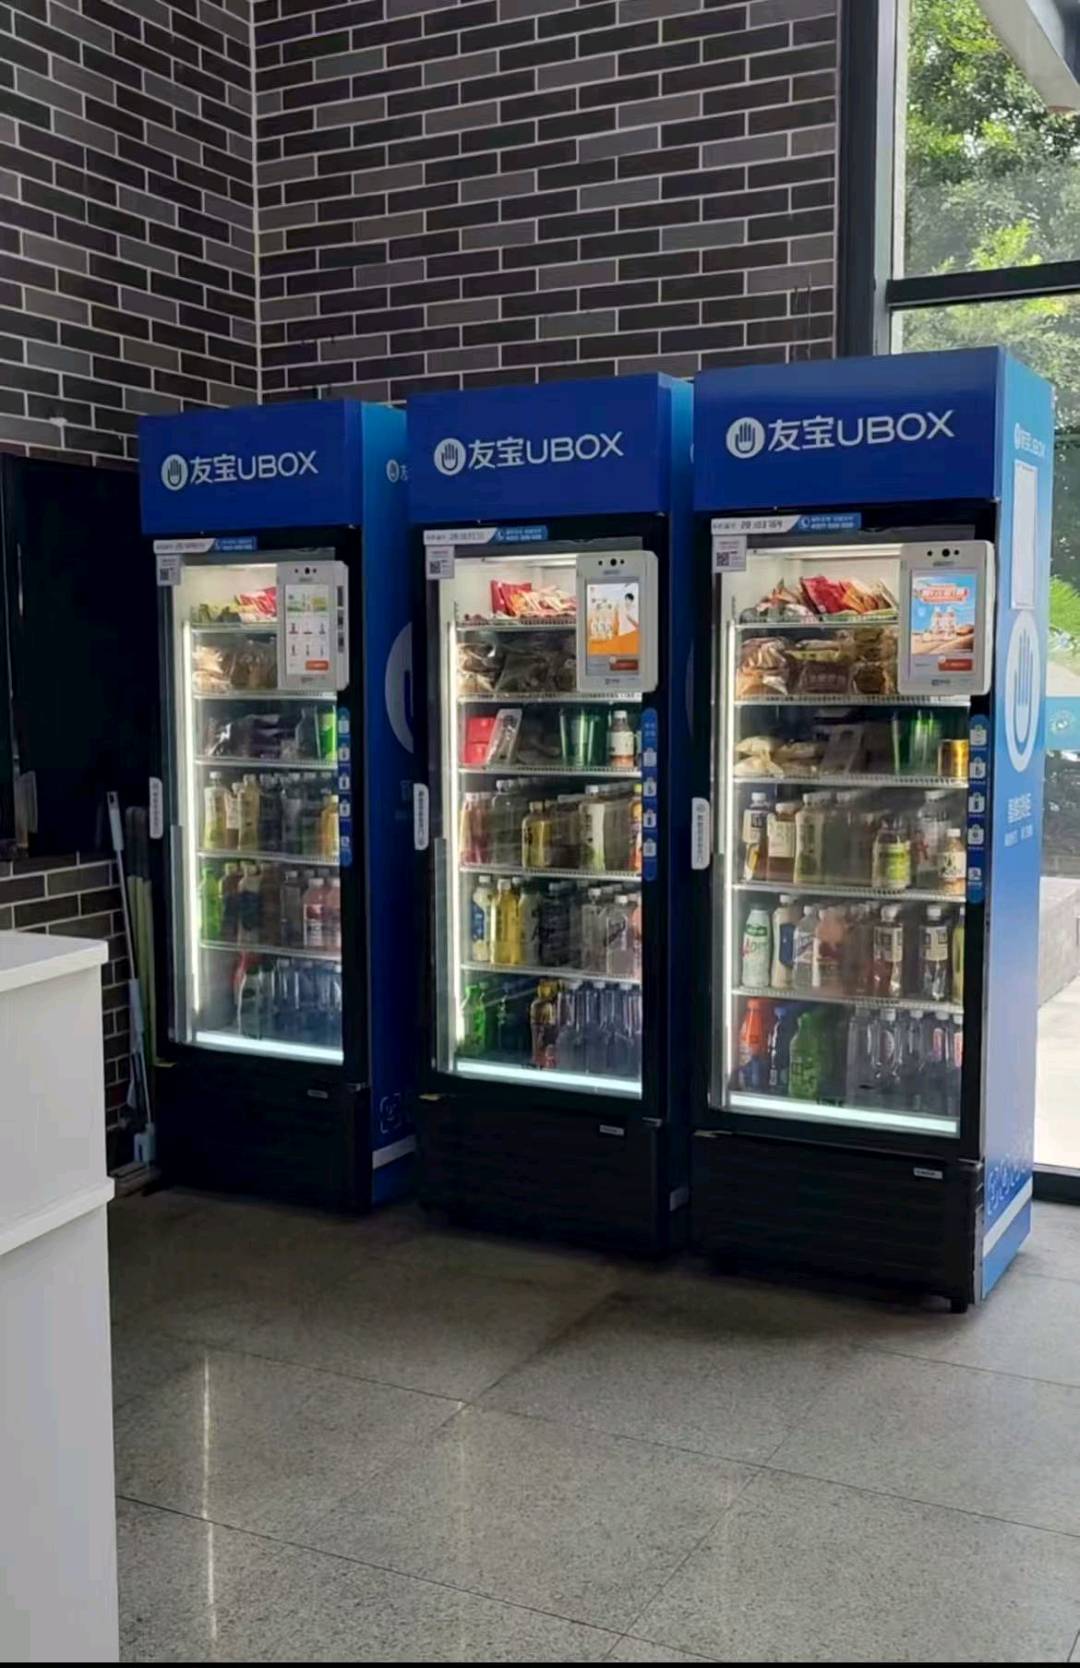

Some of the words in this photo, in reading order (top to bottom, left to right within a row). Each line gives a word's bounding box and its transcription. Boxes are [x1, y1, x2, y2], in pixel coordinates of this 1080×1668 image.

[468, 431, 624, 469] 友宝UBOX
[768, 410, 954, 452] 友宝UBOX
[190, 451, 318, 485] 友宝UBOX
